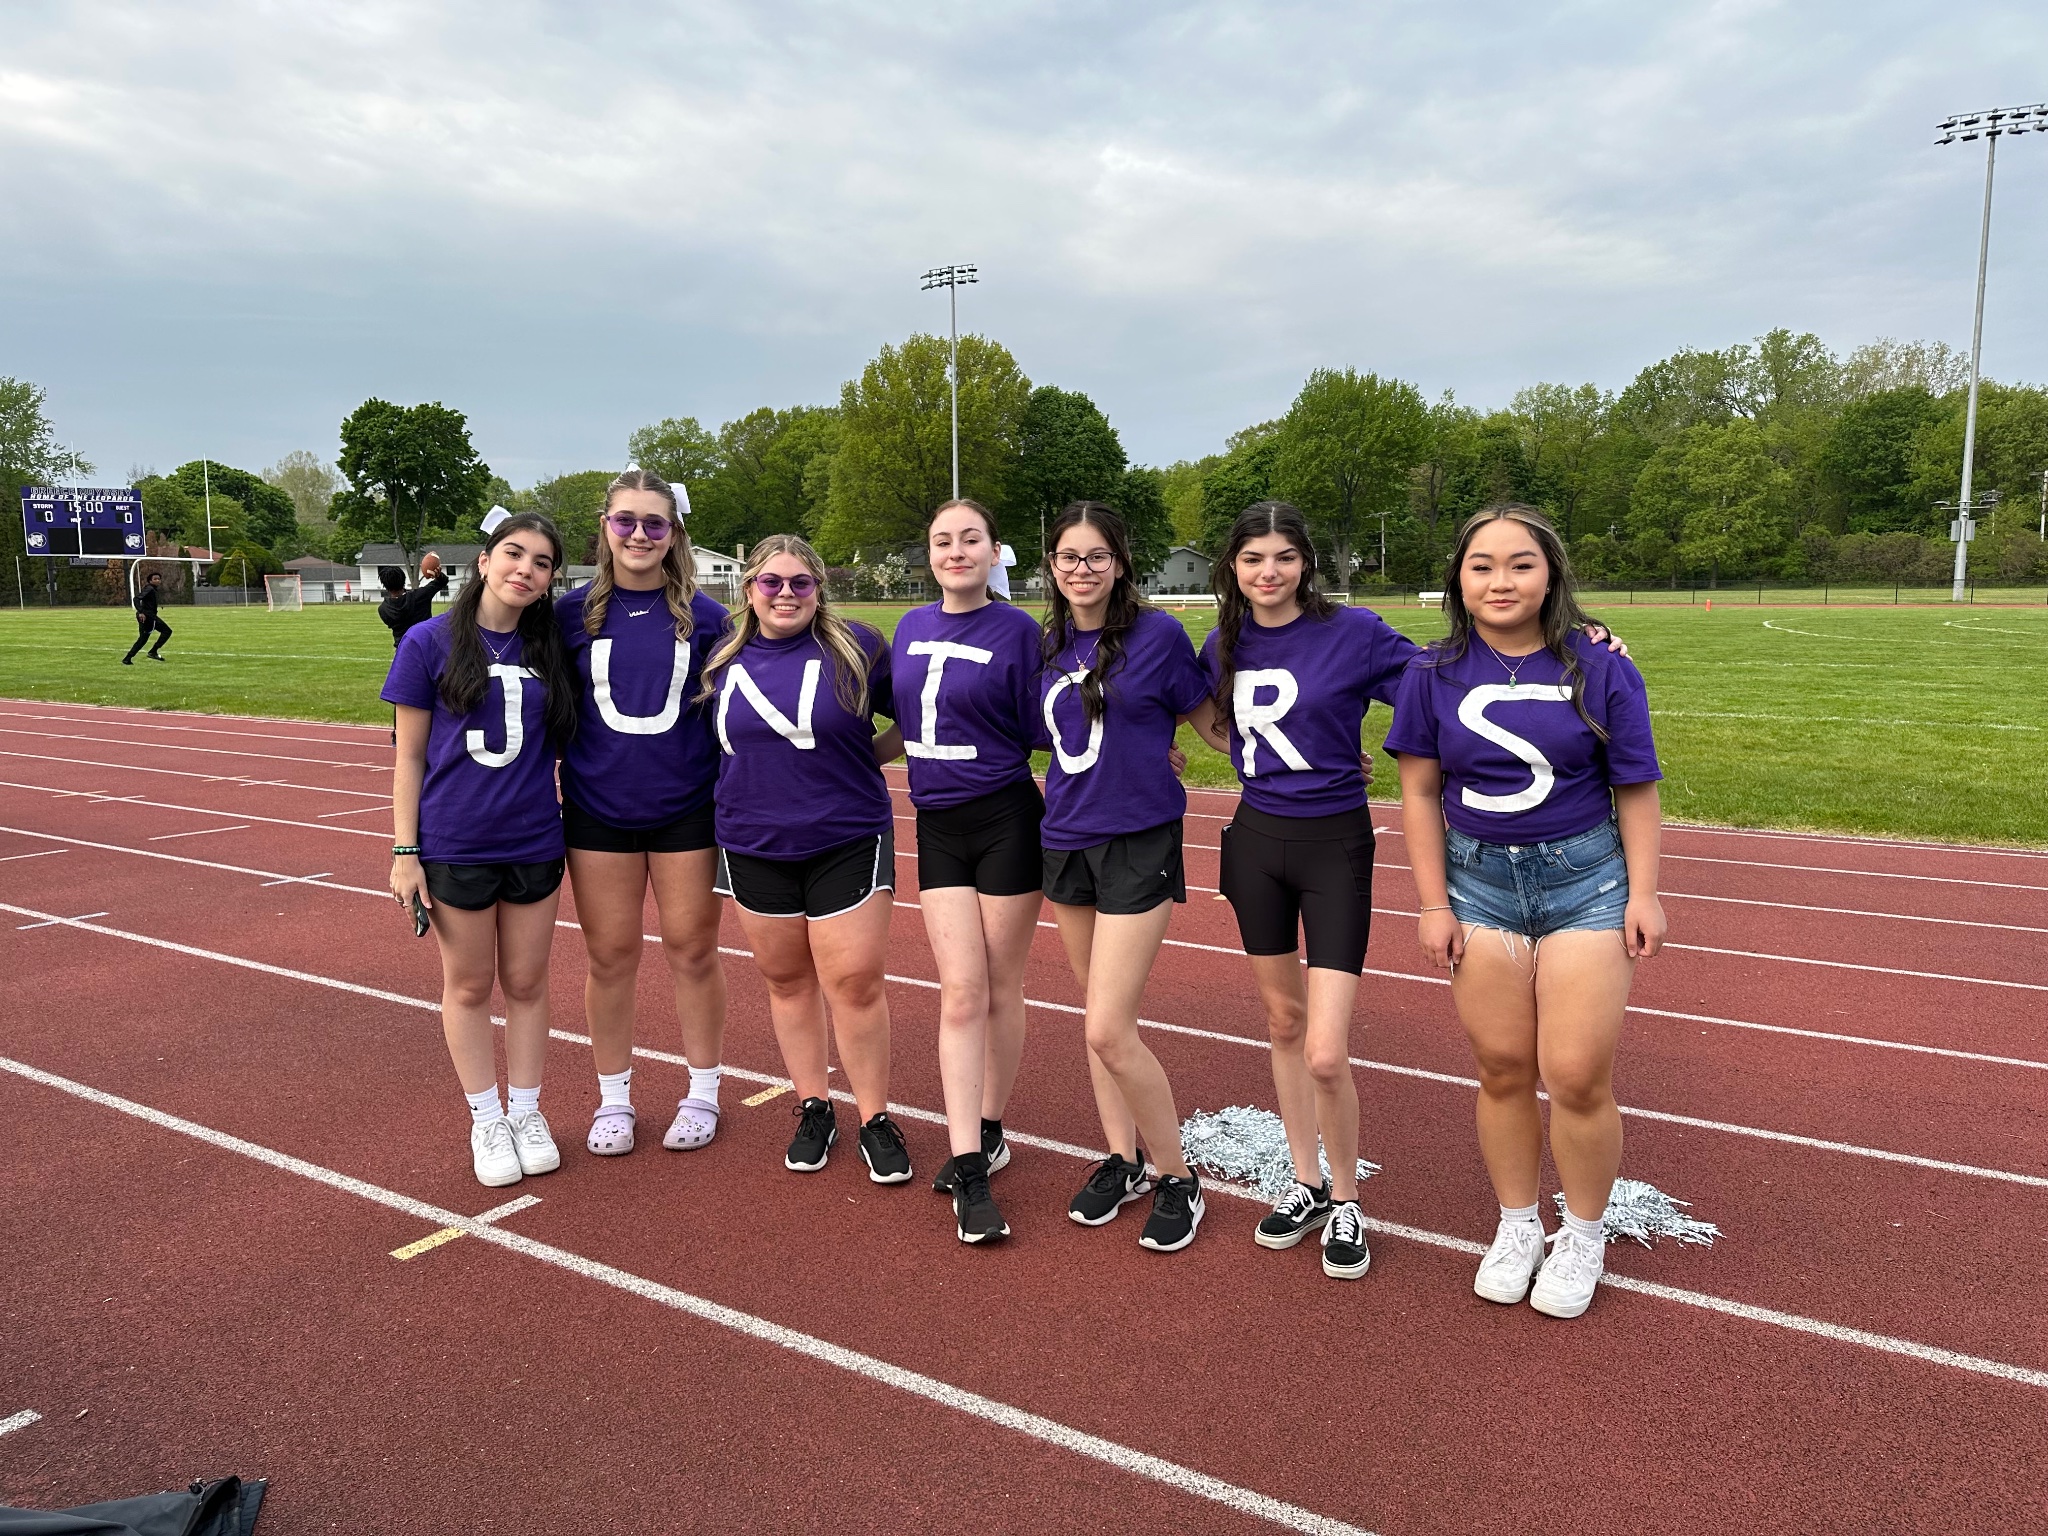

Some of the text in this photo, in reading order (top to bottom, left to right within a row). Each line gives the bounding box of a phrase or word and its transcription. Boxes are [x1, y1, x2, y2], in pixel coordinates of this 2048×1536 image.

[45, 511, 53, 522] 0
[68, 501, 103, 513] 15:00
[125, 512, 132, 523] 0
[466, 663, 540, 768] J
[590, 638, 690, 735] U
[716, 660, 820, 756] N
[903, 641, 993, 760] I
[1043, 670, 1104, 775] O
[1233, 668, 1313, 777] R
[1458, 684, 1573, 813] S
